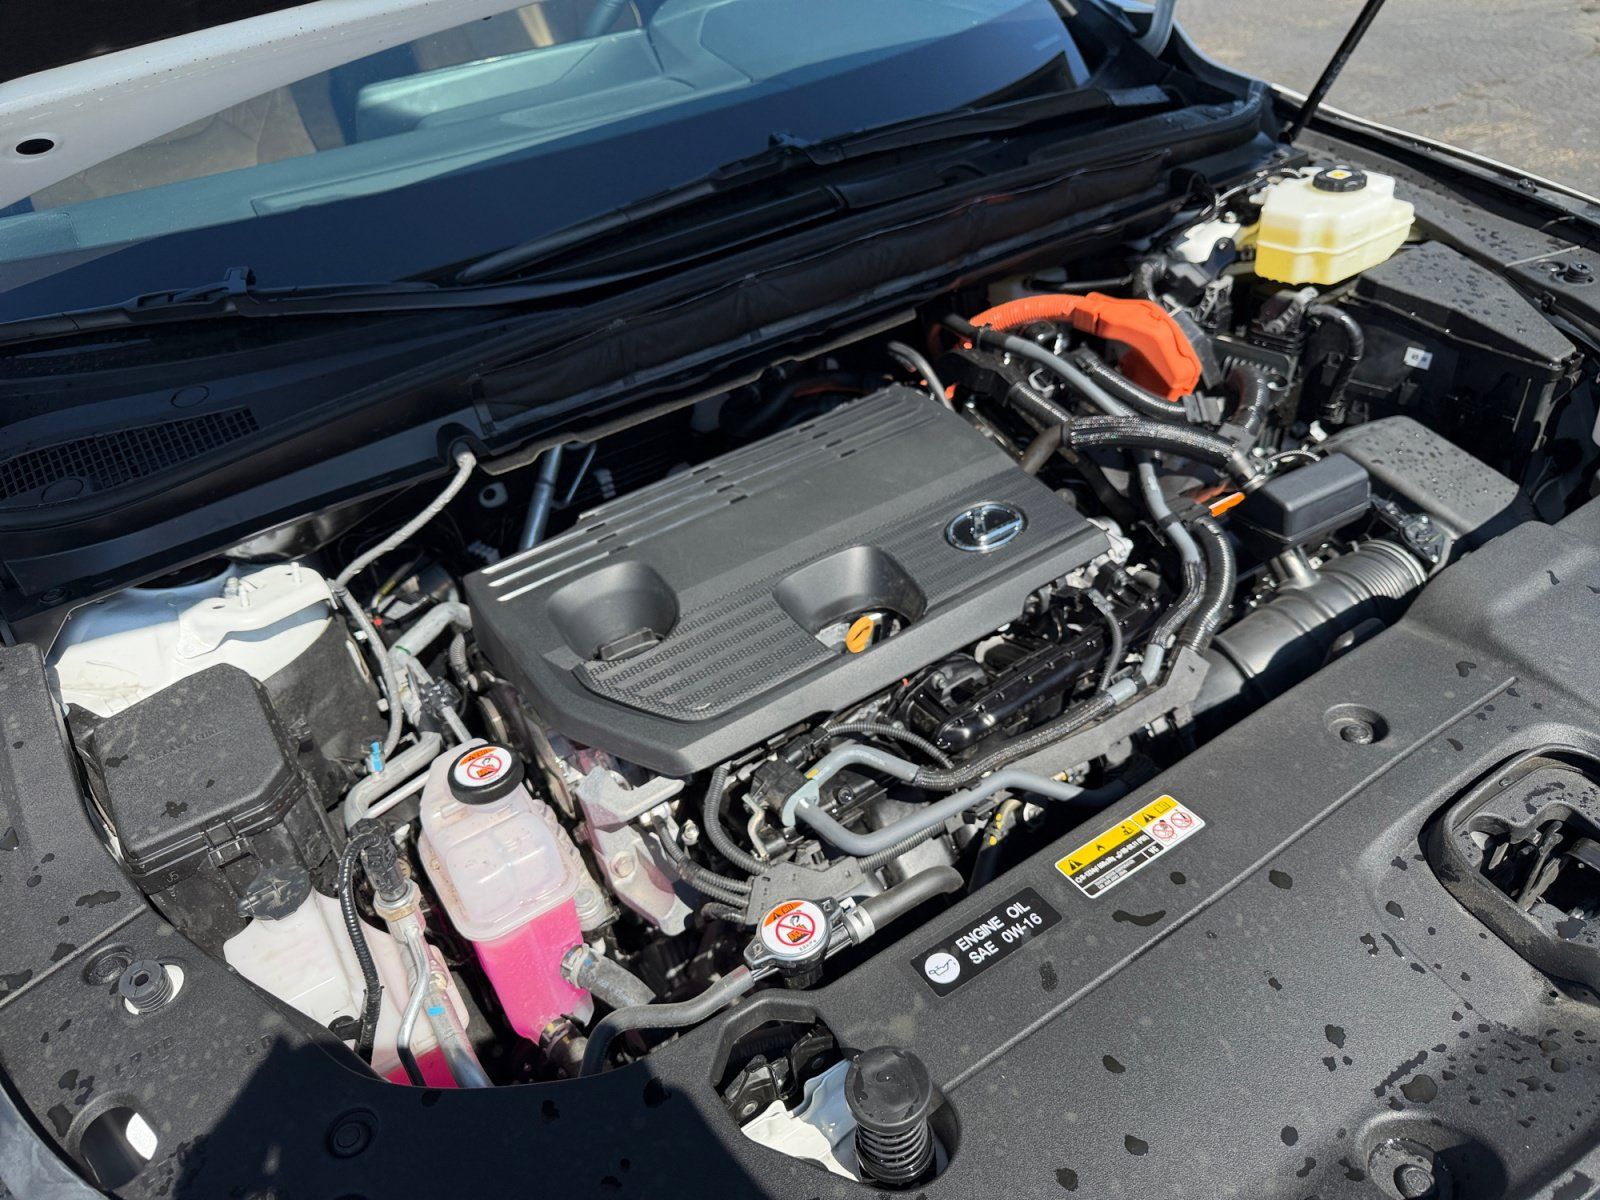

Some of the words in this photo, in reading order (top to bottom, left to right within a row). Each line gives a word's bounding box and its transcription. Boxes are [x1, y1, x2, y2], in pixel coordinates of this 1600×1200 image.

[955, 916, 1005, 952] ENGINE
[1006, 902, 1031, 919] OIL
[968, 940, 1000, 964] SAE
[1001, 912, 1043, 943] 0W-16
